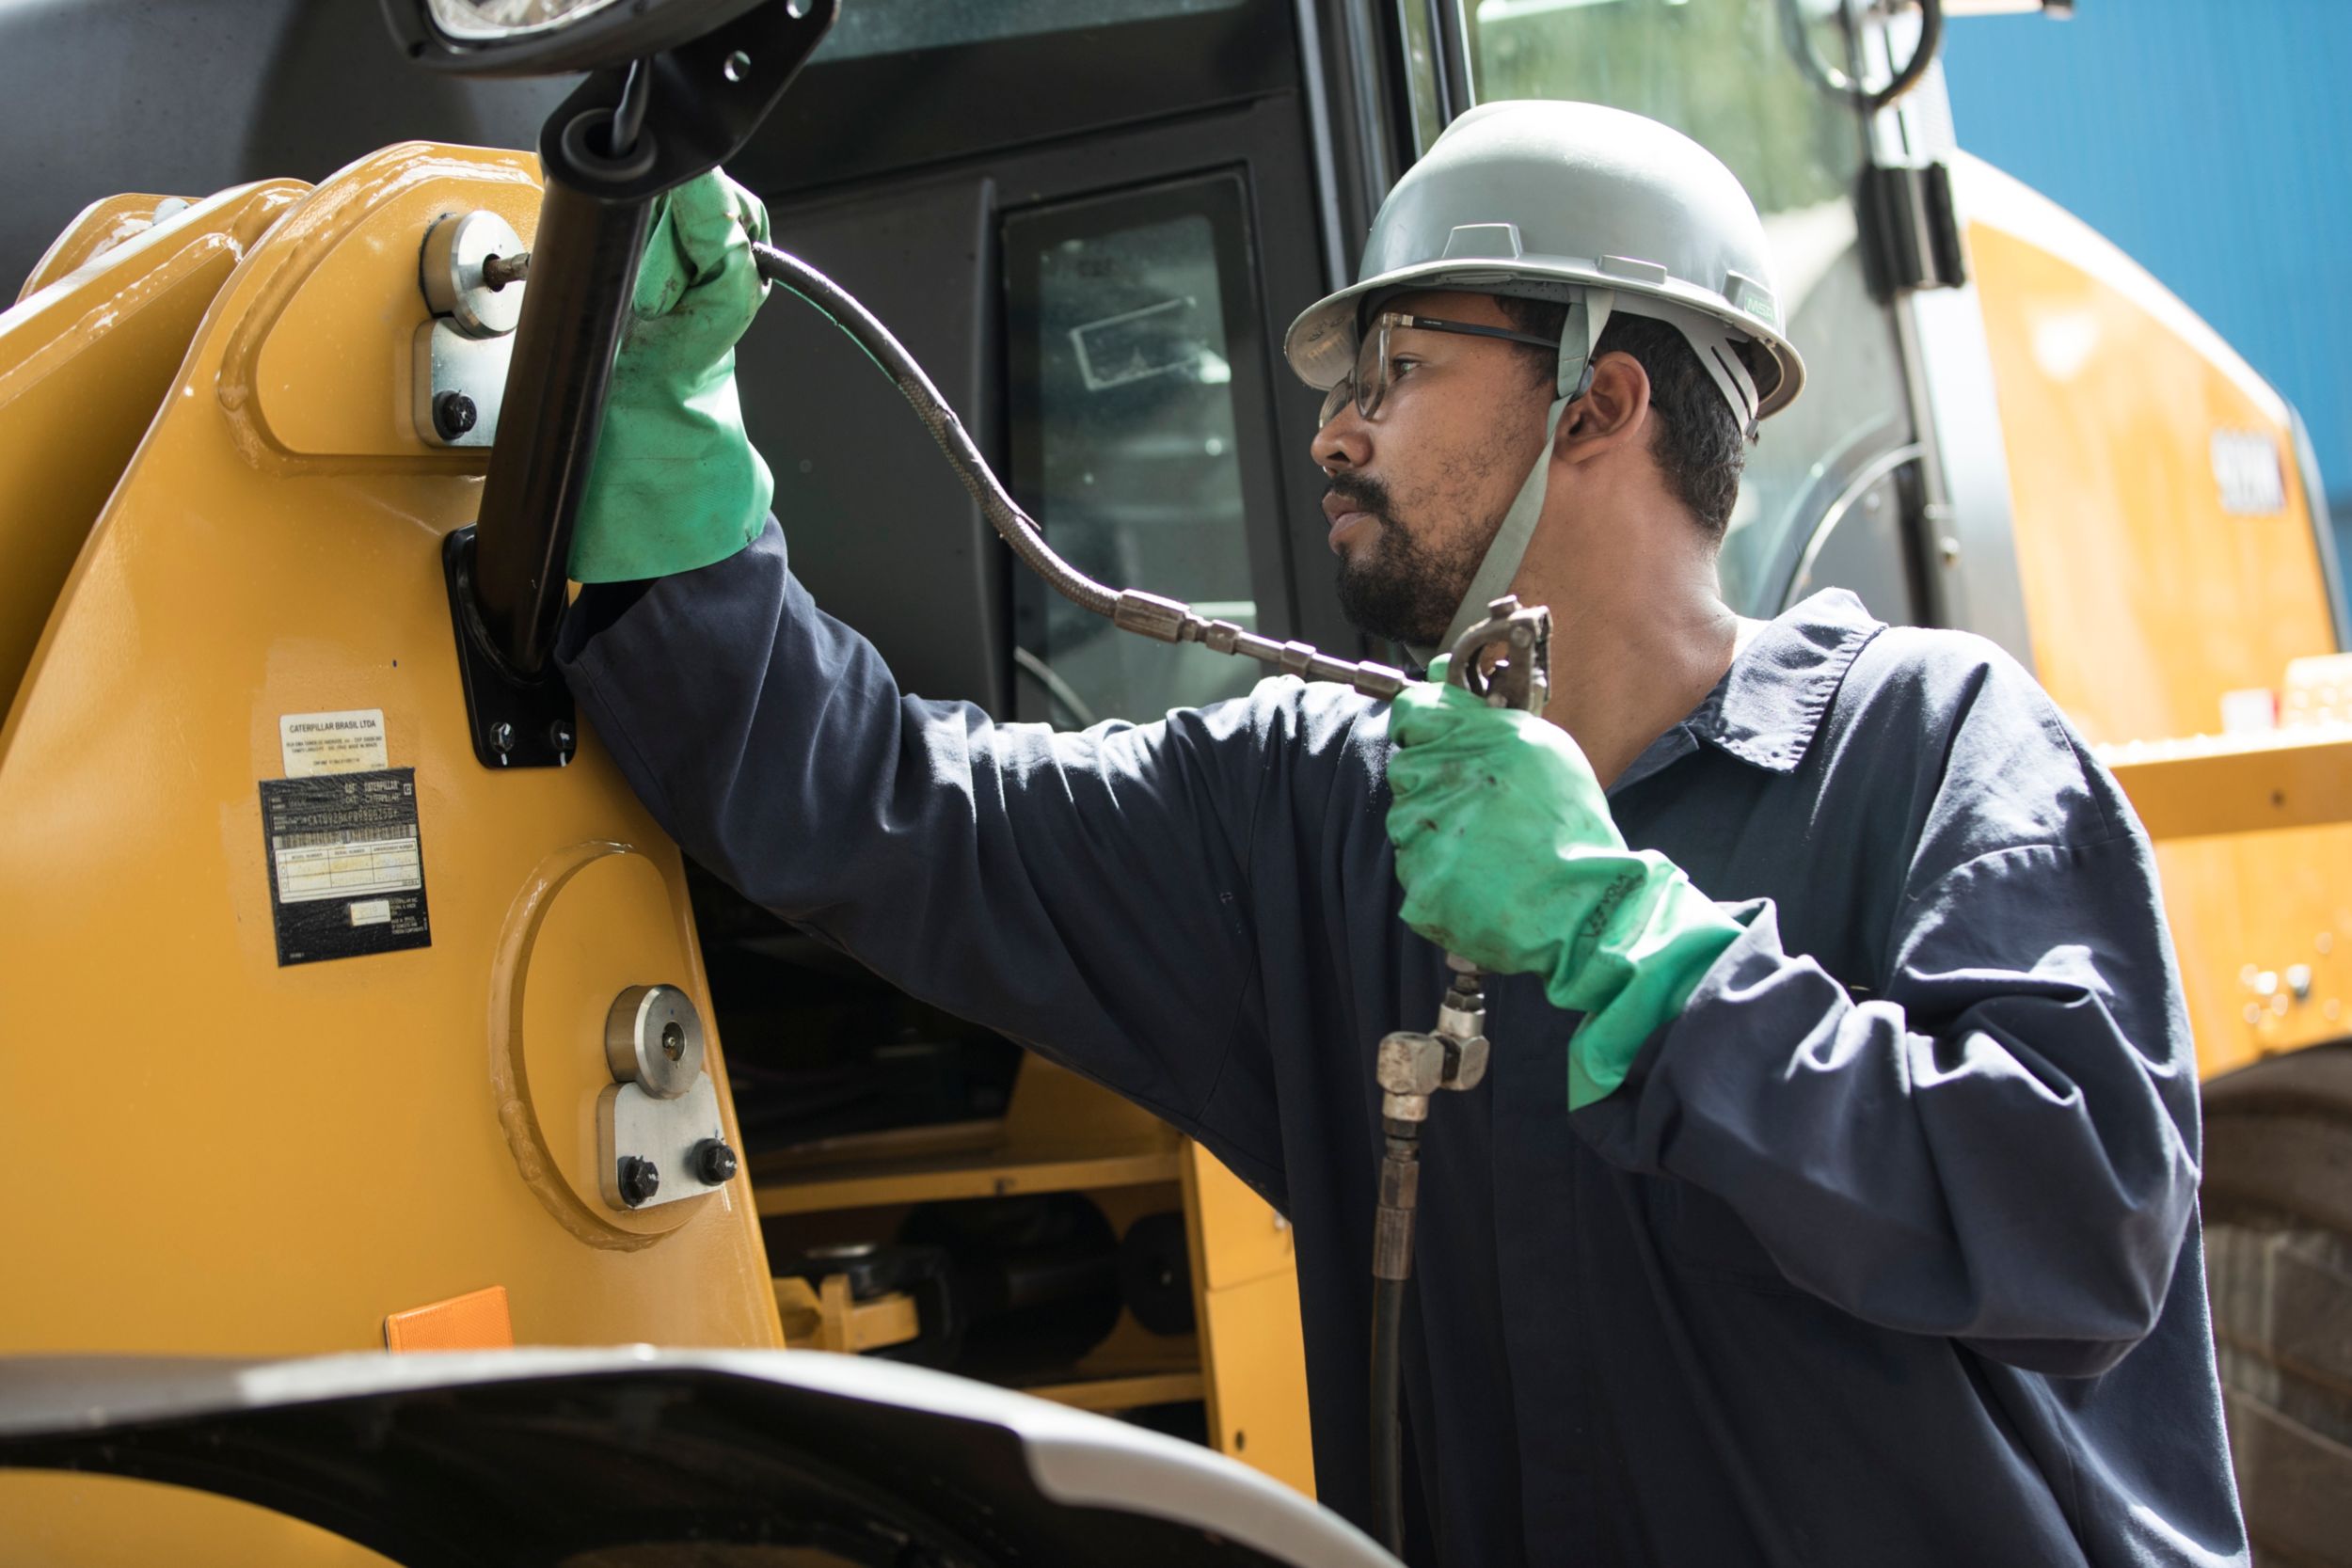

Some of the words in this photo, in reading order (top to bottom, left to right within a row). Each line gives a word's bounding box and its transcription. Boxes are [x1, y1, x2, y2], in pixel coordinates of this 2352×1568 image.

[1747, 297, 1774, 321] MSA
[290, 721, 334, 733] CATERPILLAR
[335, 721, 358, 730] BRASIL
[359, 720, 375, 728] LTDA
